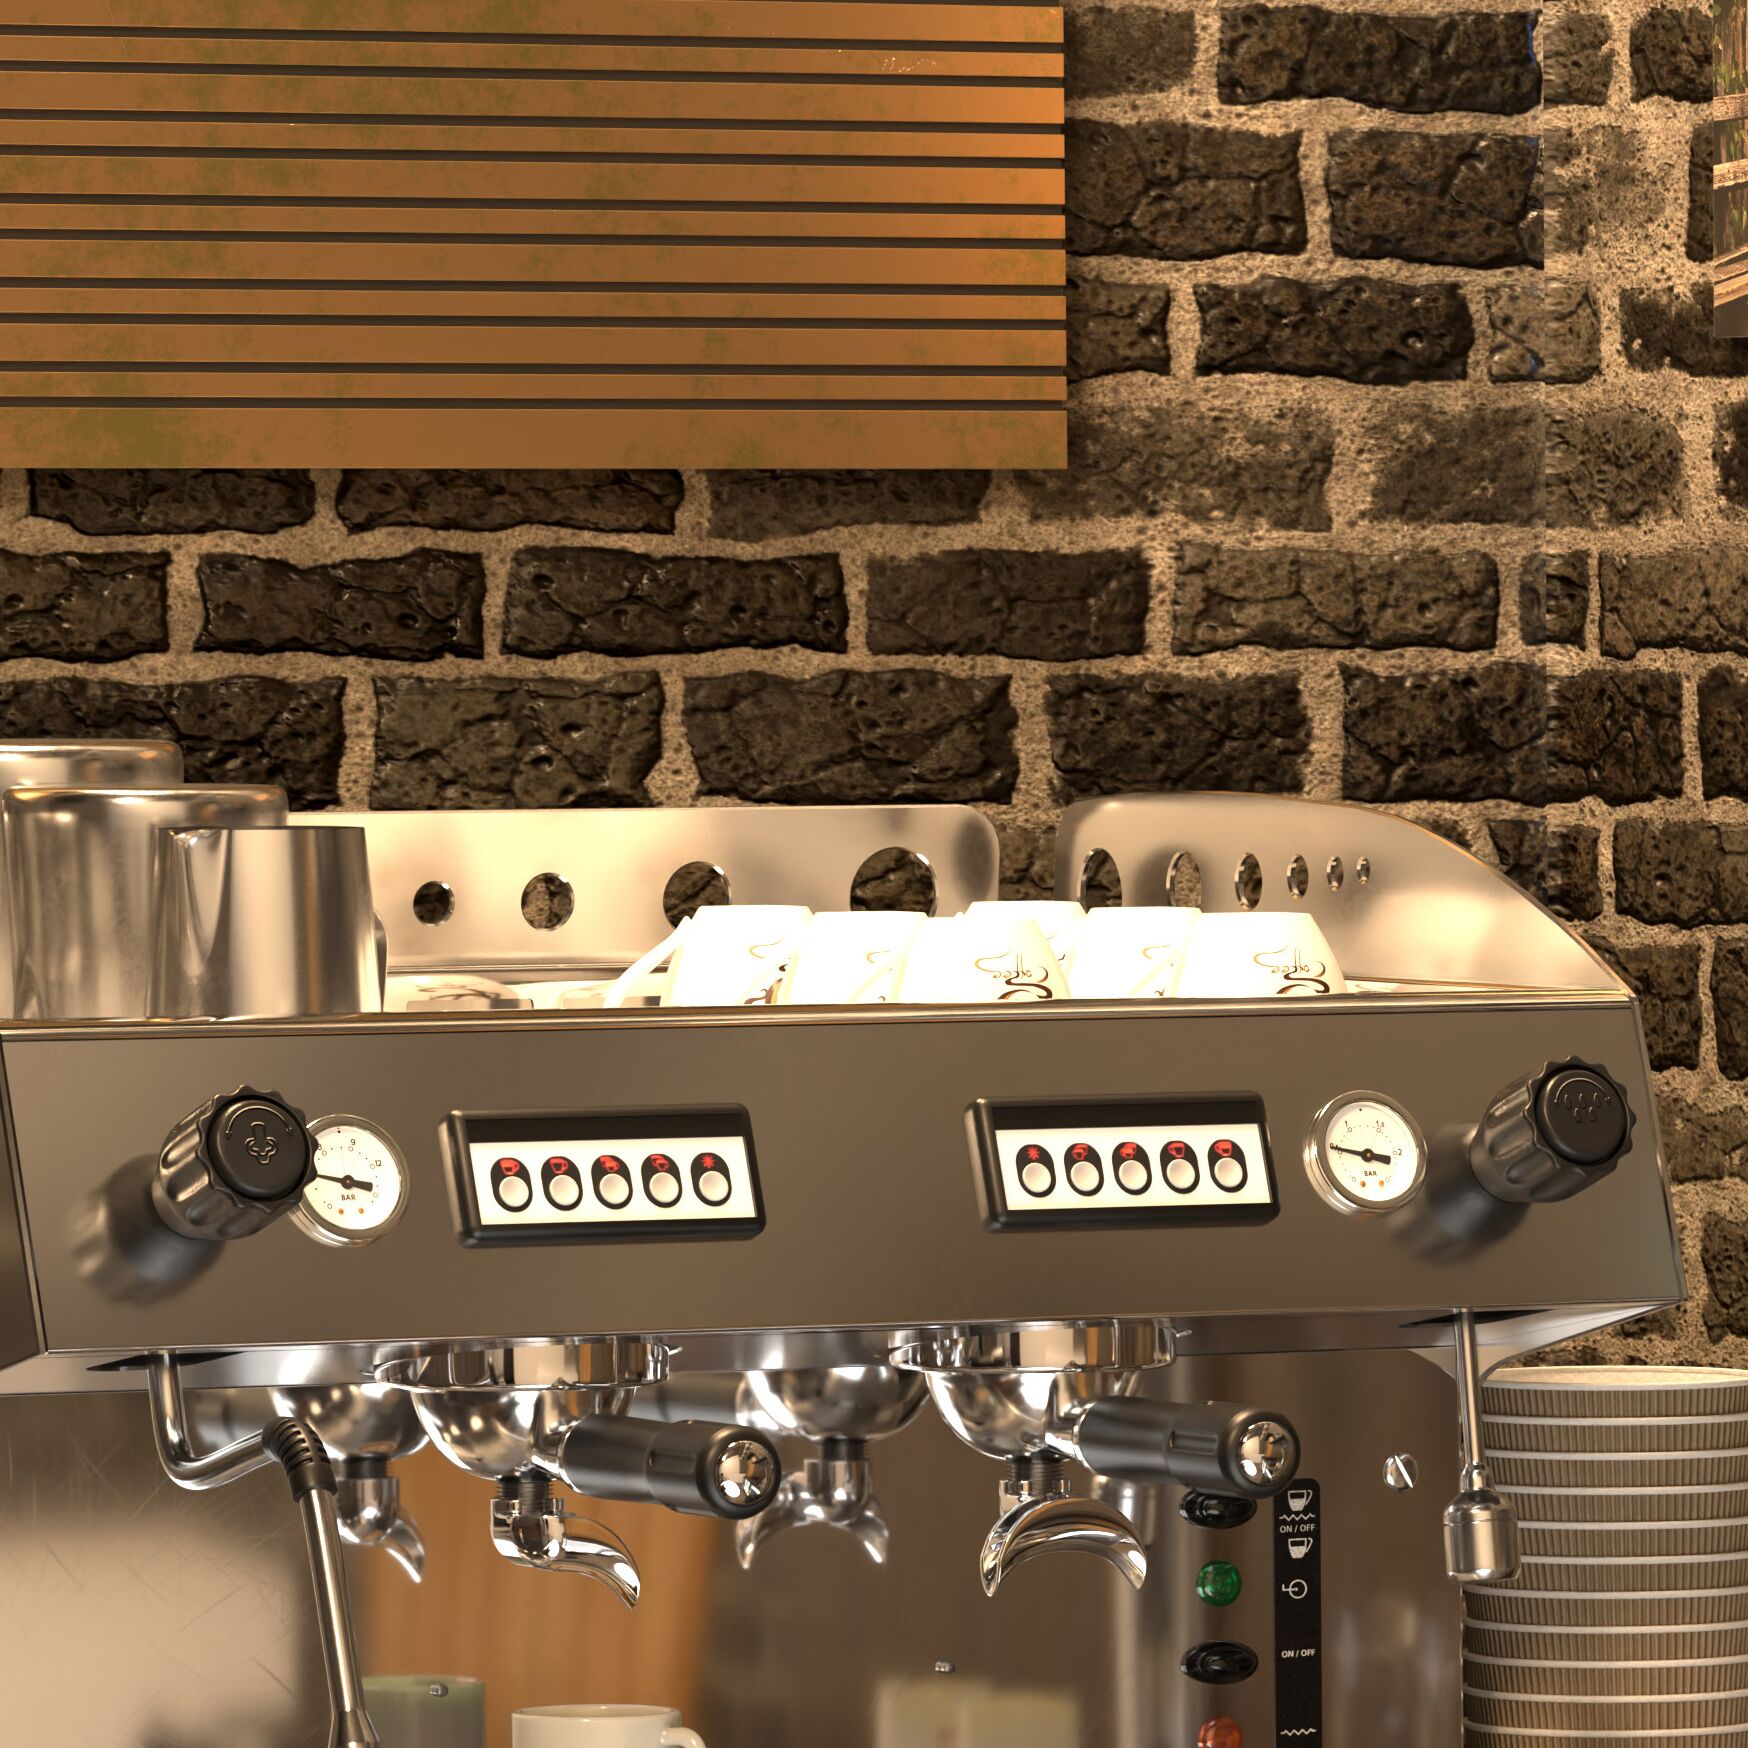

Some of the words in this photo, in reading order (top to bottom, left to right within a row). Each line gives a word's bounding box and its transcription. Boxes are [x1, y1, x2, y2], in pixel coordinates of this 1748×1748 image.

[1280, 1525, 1293, 1533] ON
[1300, 1523, 1316, 1532] OFF
[1281, 1650, 1294, 1658] ON
[1301, 1648, 1316, 1657] OFF
